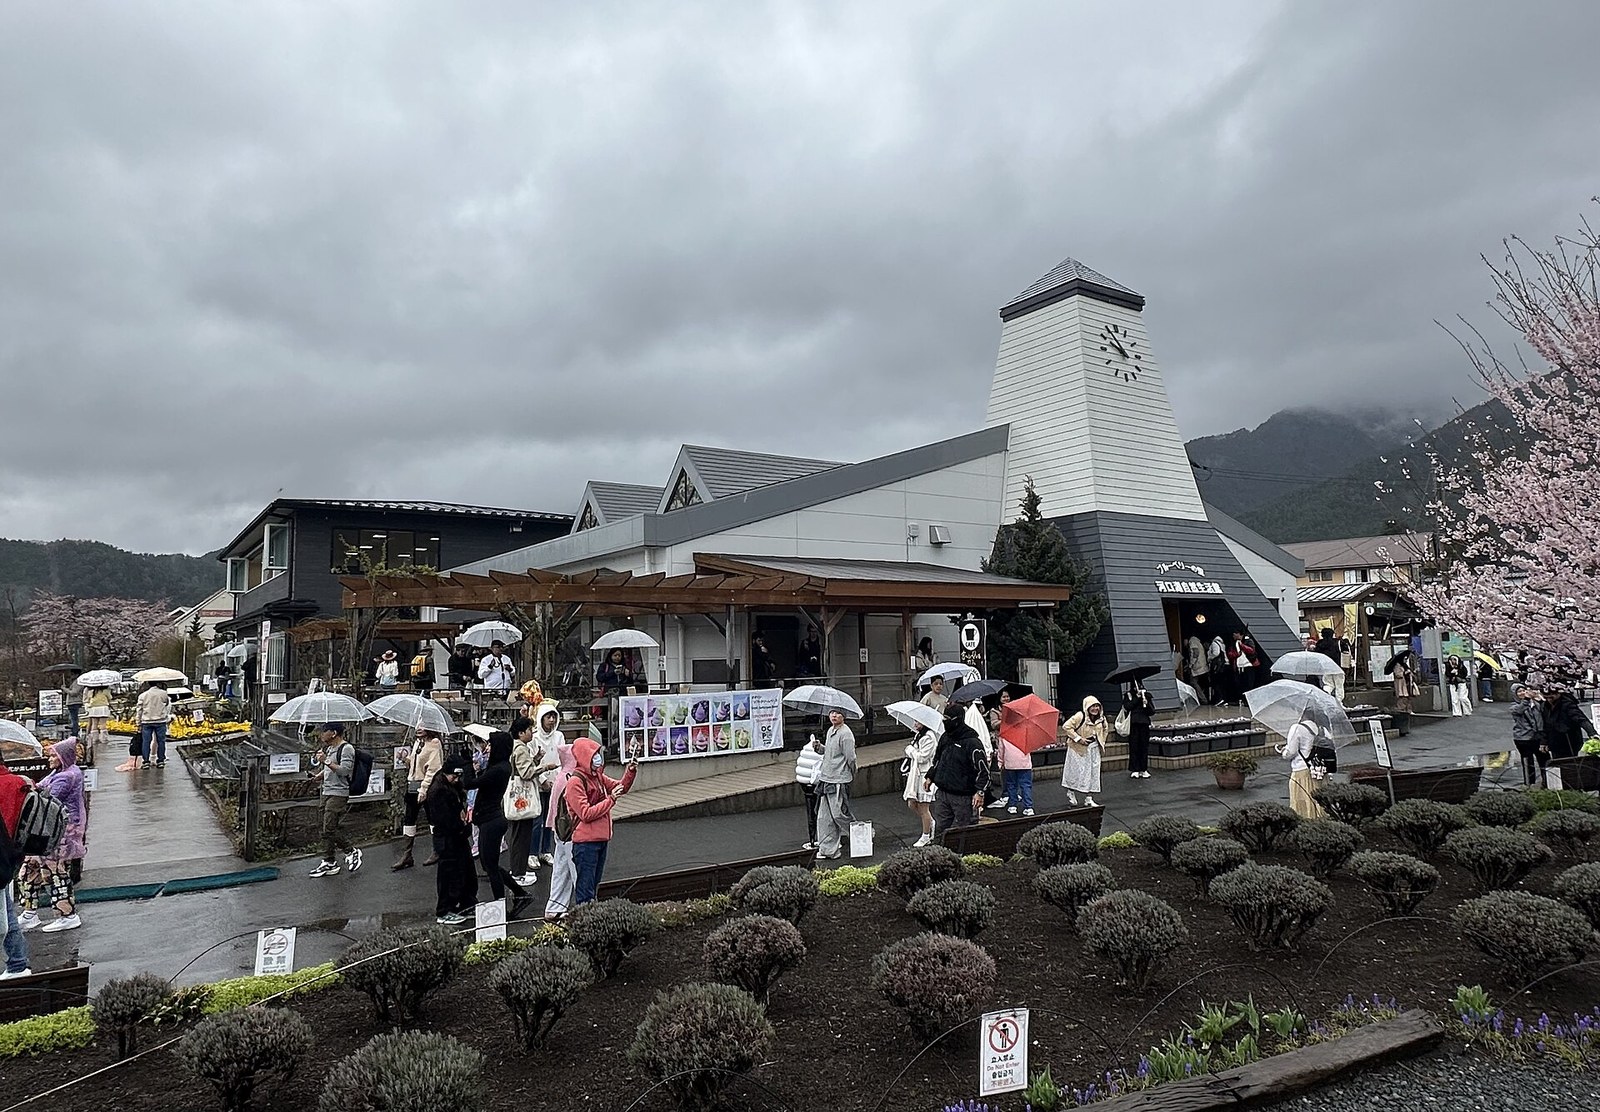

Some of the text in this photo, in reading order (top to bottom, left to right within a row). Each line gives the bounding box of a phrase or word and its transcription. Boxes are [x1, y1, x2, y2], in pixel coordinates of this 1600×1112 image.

[1155, 580, 1223, 593] 河口湖自然生活館
[991, 1054, 1014, 1063] 立入禁止
[992, 1069, 1014, 1079] 출입금지
